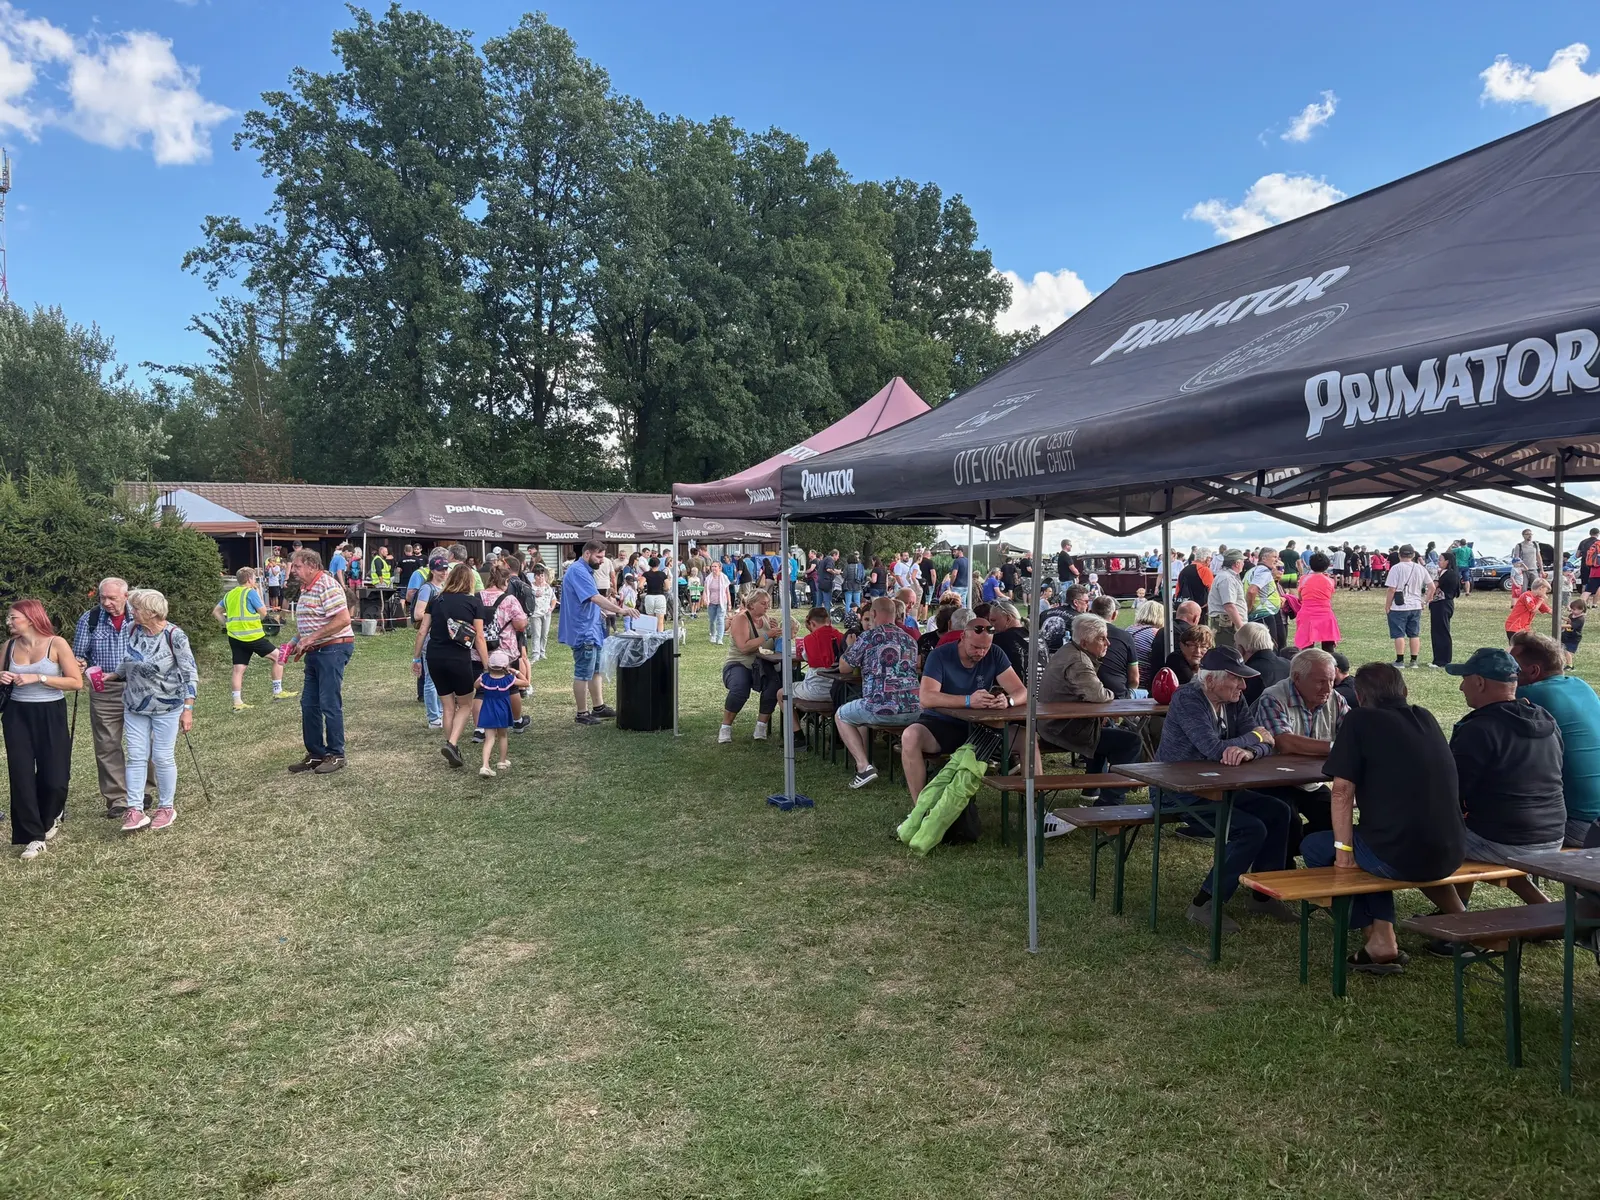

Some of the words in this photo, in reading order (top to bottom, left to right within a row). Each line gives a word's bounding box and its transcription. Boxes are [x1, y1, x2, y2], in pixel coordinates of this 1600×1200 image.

[1090, 265, 1351, 366] PRIMATOR
[1304, 328, 1600, 441] PRIMATOR
[1046, 429, 1078, 450] CESTU
[801, 468, 856, 502] PRIMATOR
[445, 504, 505, 516] PRIMATOR
[380, 523, 417, 535] PRIMATOR
[545, 531, 579, 540] PRIMATOR
[605, 530, 636, 539] PRIMATOR
